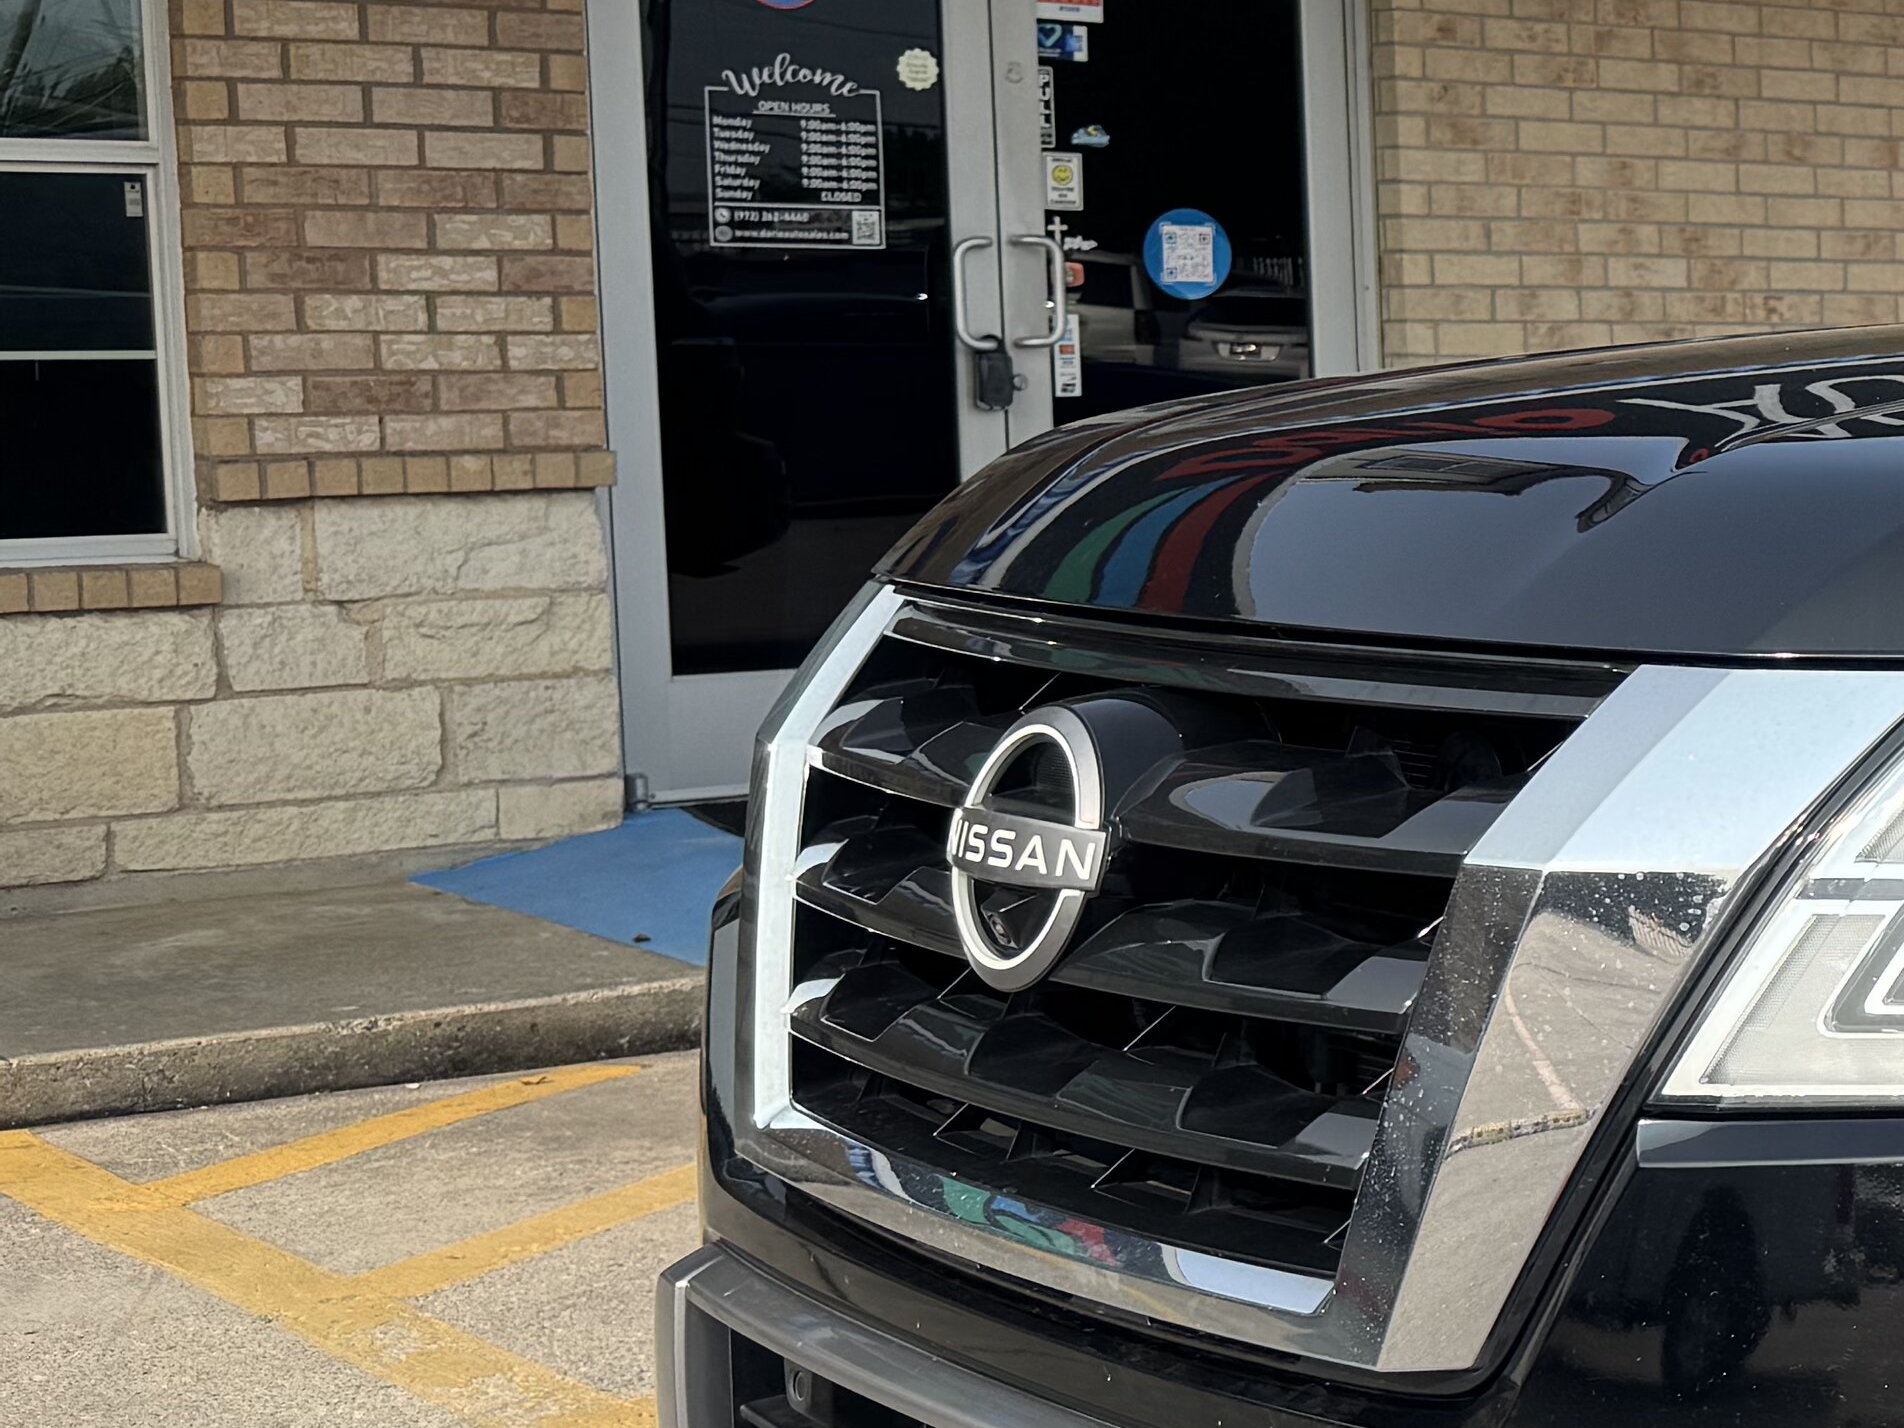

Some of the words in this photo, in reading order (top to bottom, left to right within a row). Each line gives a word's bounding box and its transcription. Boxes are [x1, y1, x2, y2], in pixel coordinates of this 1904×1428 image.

[721, 52, 861, 97] Welcome
[757, 100, 790, 113] OPEN
[791, 102, 831, 114] HOURS
[1039, 71, 1052, 129] PULL
[712, 115, 752, 129] Monday
[713, 127, 755, 141] Tuesday
[713, 140, 771, 154] Wednesday
[714, 151, 761, 165] Thursday
[714, 164, 746, 176] Friday
[715, 175, 761, 189] Saturday
[715, 187, 753, 200] Sunday
[820, 191, 862, 203] CLOSED
[951, 818, 1096, 881] NISSAN
